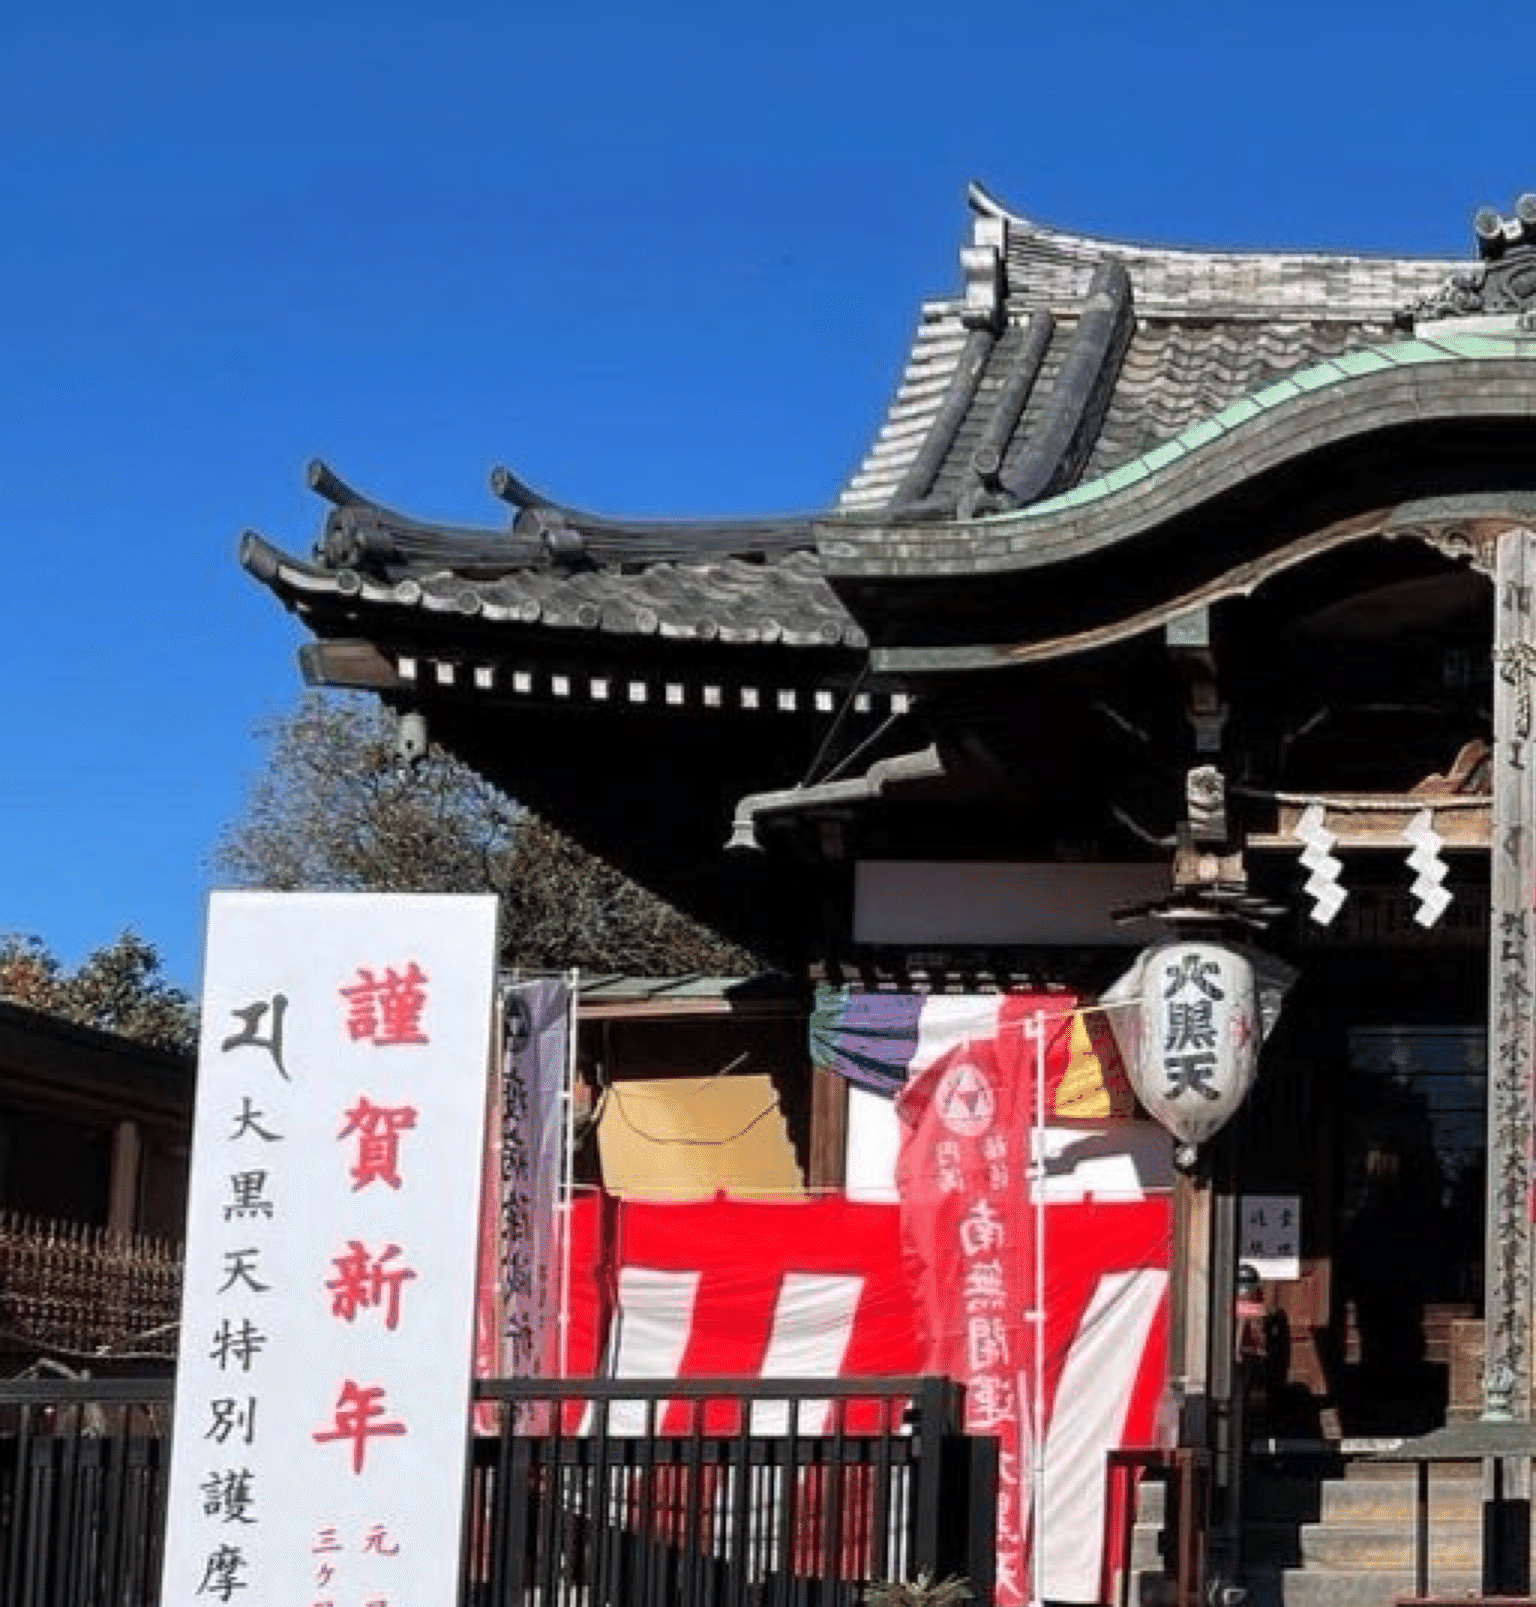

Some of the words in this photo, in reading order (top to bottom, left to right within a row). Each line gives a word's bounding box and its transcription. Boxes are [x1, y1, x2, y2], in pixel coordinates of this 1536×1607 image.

[196, 1096, 284, 1603] 大黒天特別護摩
[311, 962, 430, 1475] 謹賀新年
[363, 1524, 400, 1607] 元
